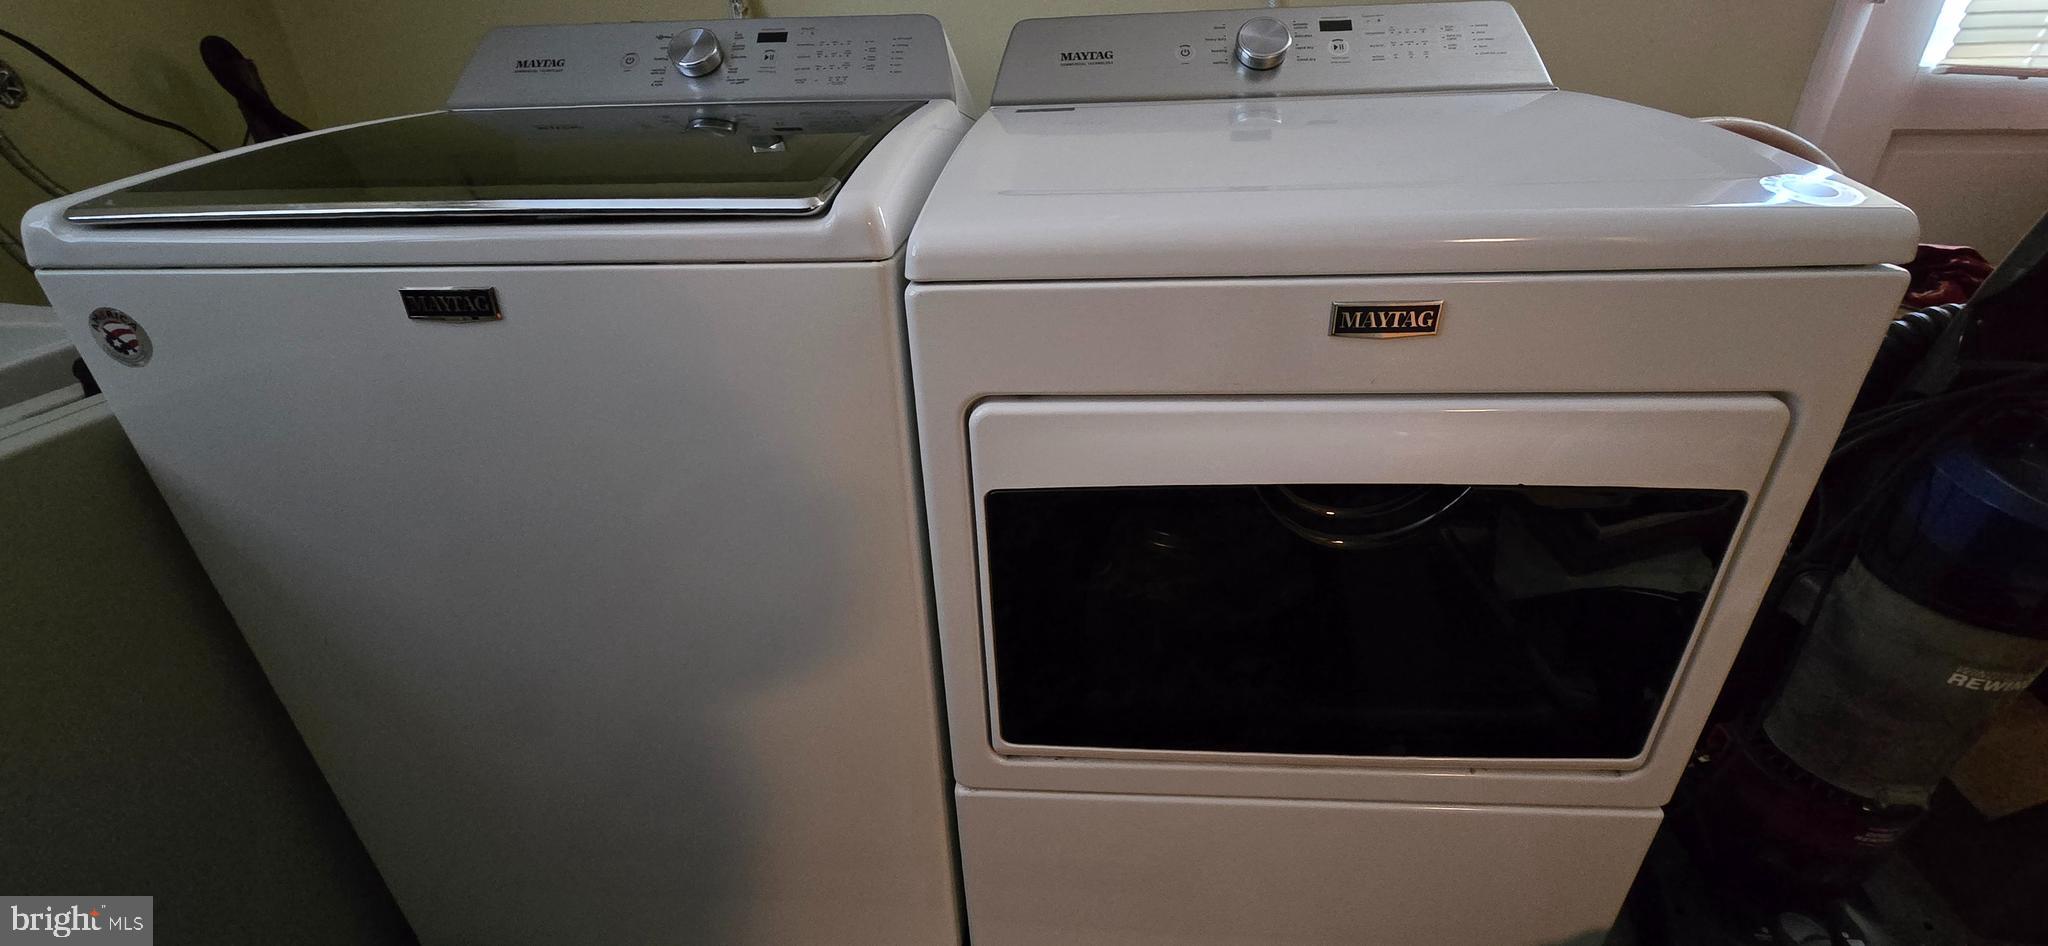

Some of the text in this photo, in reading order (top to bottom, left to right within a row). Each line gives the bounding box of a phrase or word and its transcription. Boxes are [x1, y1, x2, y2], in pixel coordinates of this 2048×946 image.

[515, 58, 566, 69] MAYTAG
[1061, 51, 1113, 61] MAYTAG
[406, 295, 490, 313] MAYTAG
[1341, 311, 1433, 328] MAYTAG
[1947, 672, 2028, 692] REWIN
